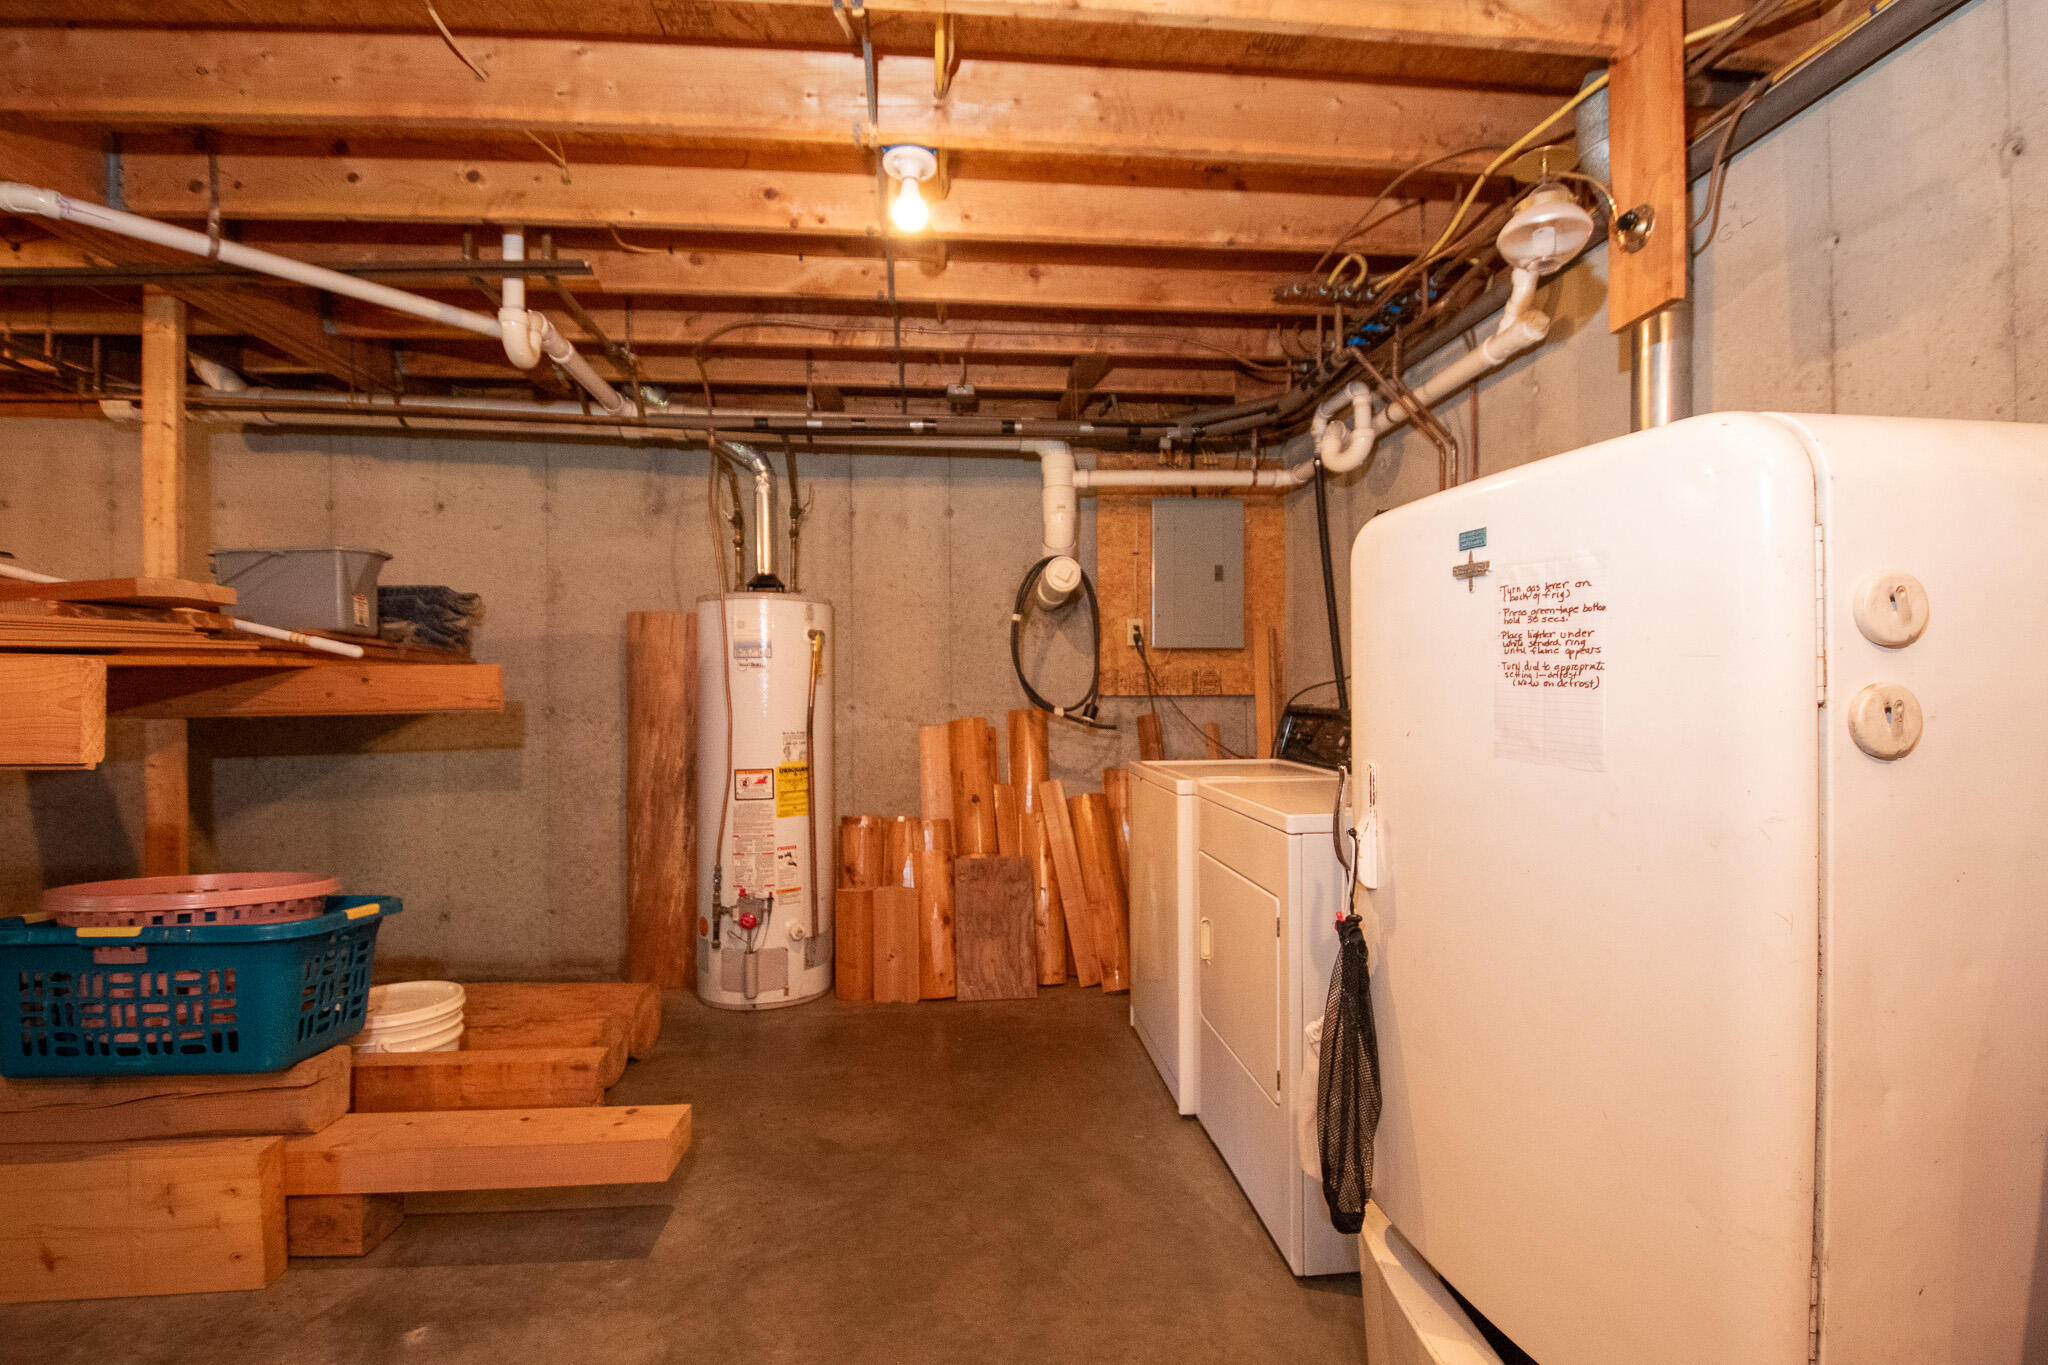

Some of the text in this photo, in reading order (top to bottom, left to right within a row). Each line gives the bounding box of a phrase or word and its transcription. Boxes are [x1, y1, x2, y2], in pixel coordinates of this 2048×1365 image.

[1575, 580, 1592, 588] on
[1503, 608, 1527, 617] Press
[1503, 616, 1520, 624] hold
[1527, 616, 1539, 624] 30
[1501, 631, 1523, 640] Place
[1560, 628, 1595, 639] under
[1565, 638, 1586, 649] ring
[1530, 646, 1559, 655] flame
[1565, 646, 1602, 660] appears
[1524, 660, 1539, 671] dial
[1542, 661, 1550, 670] to
[1554, 661, 1605, 675] appropriate
